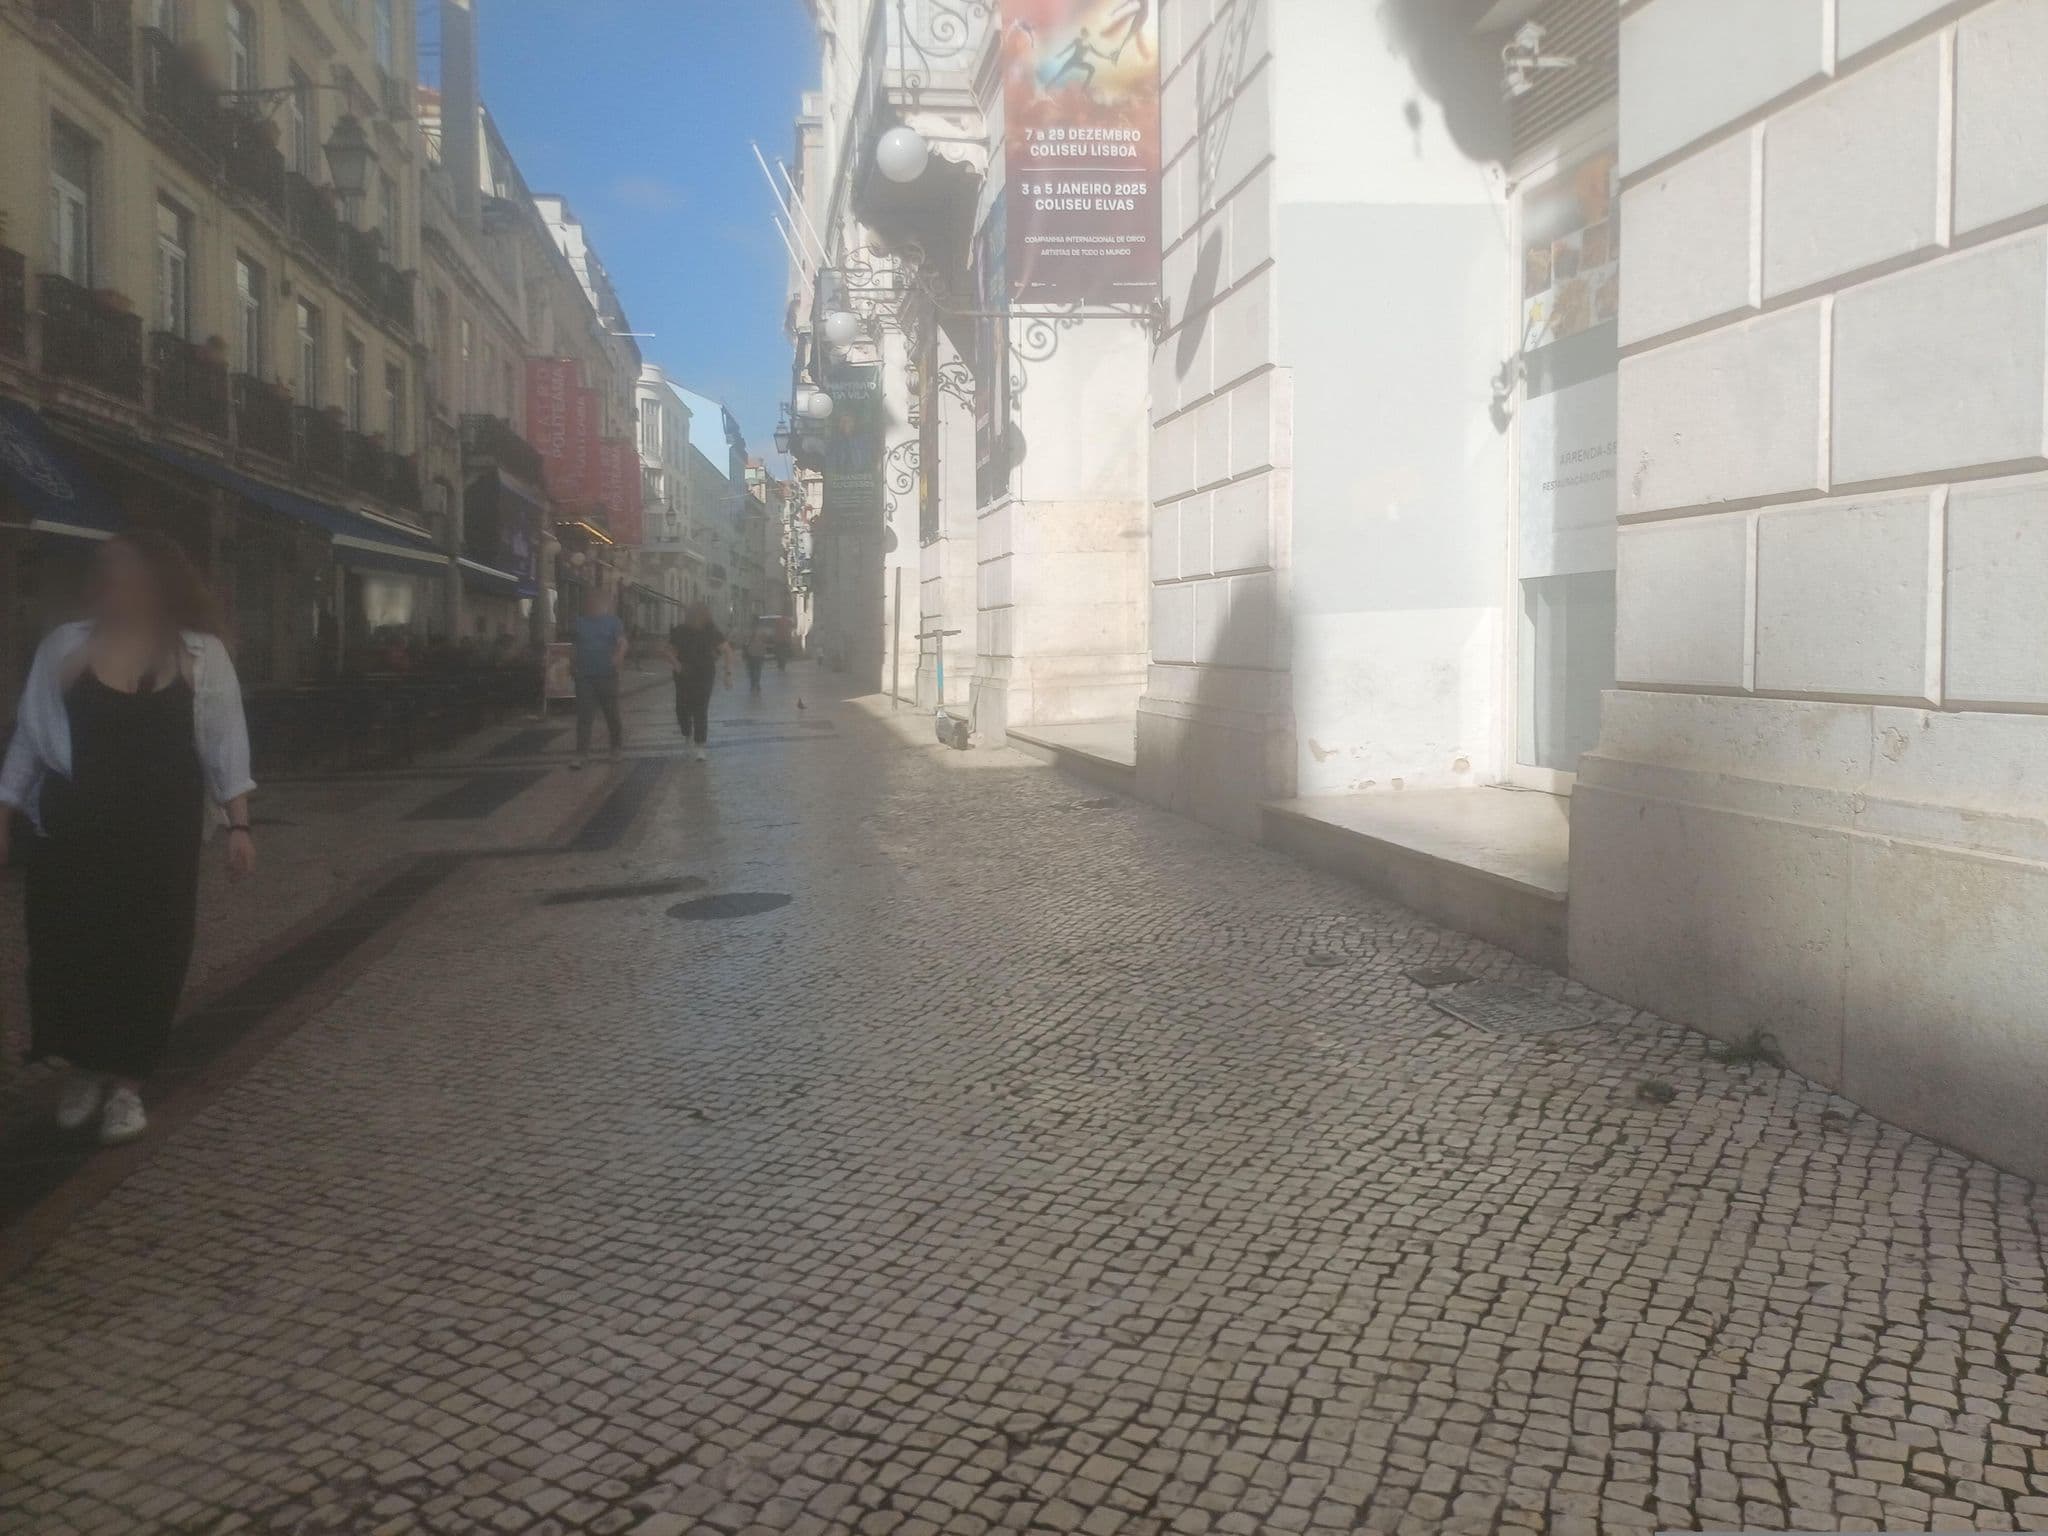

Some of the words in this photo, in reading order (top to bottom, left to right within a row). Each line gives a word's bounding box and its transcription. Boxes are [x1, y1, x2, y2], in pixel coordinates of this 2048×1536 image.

[1025, 129, 1033, 141] 7
[1036, 131, 1045, 141] a
[1048, 129, 1065, 141] 29
[1068, 129, 1141, 141] DEZEMBRO
[1030, 145, 1087, 156] COLISEU
[1091, 146, 1137, 157] LISBOA
[1022, 184, 1029, 195] 3
[1033, 185, 1041, 195] a
[1045, 184, 1053, 195] 5
[1056, 184, 1111, 195] JANEIRO
[1114, 184, 1147, 195] 2025
[1035, 199, 1091, 210] COLISEU
[1095, 199, 1135, 210] ELVAS
[1024, 235, 1065, 244] COMPANHIA
[1066, 236, 1115, 244] INTERNACIONAL
[1126, 235, 1146, 243] CIRCO
[1040, 248, 1070, 256] ARTISTAS
[1106, 248, 1132, 256] MUNDO
